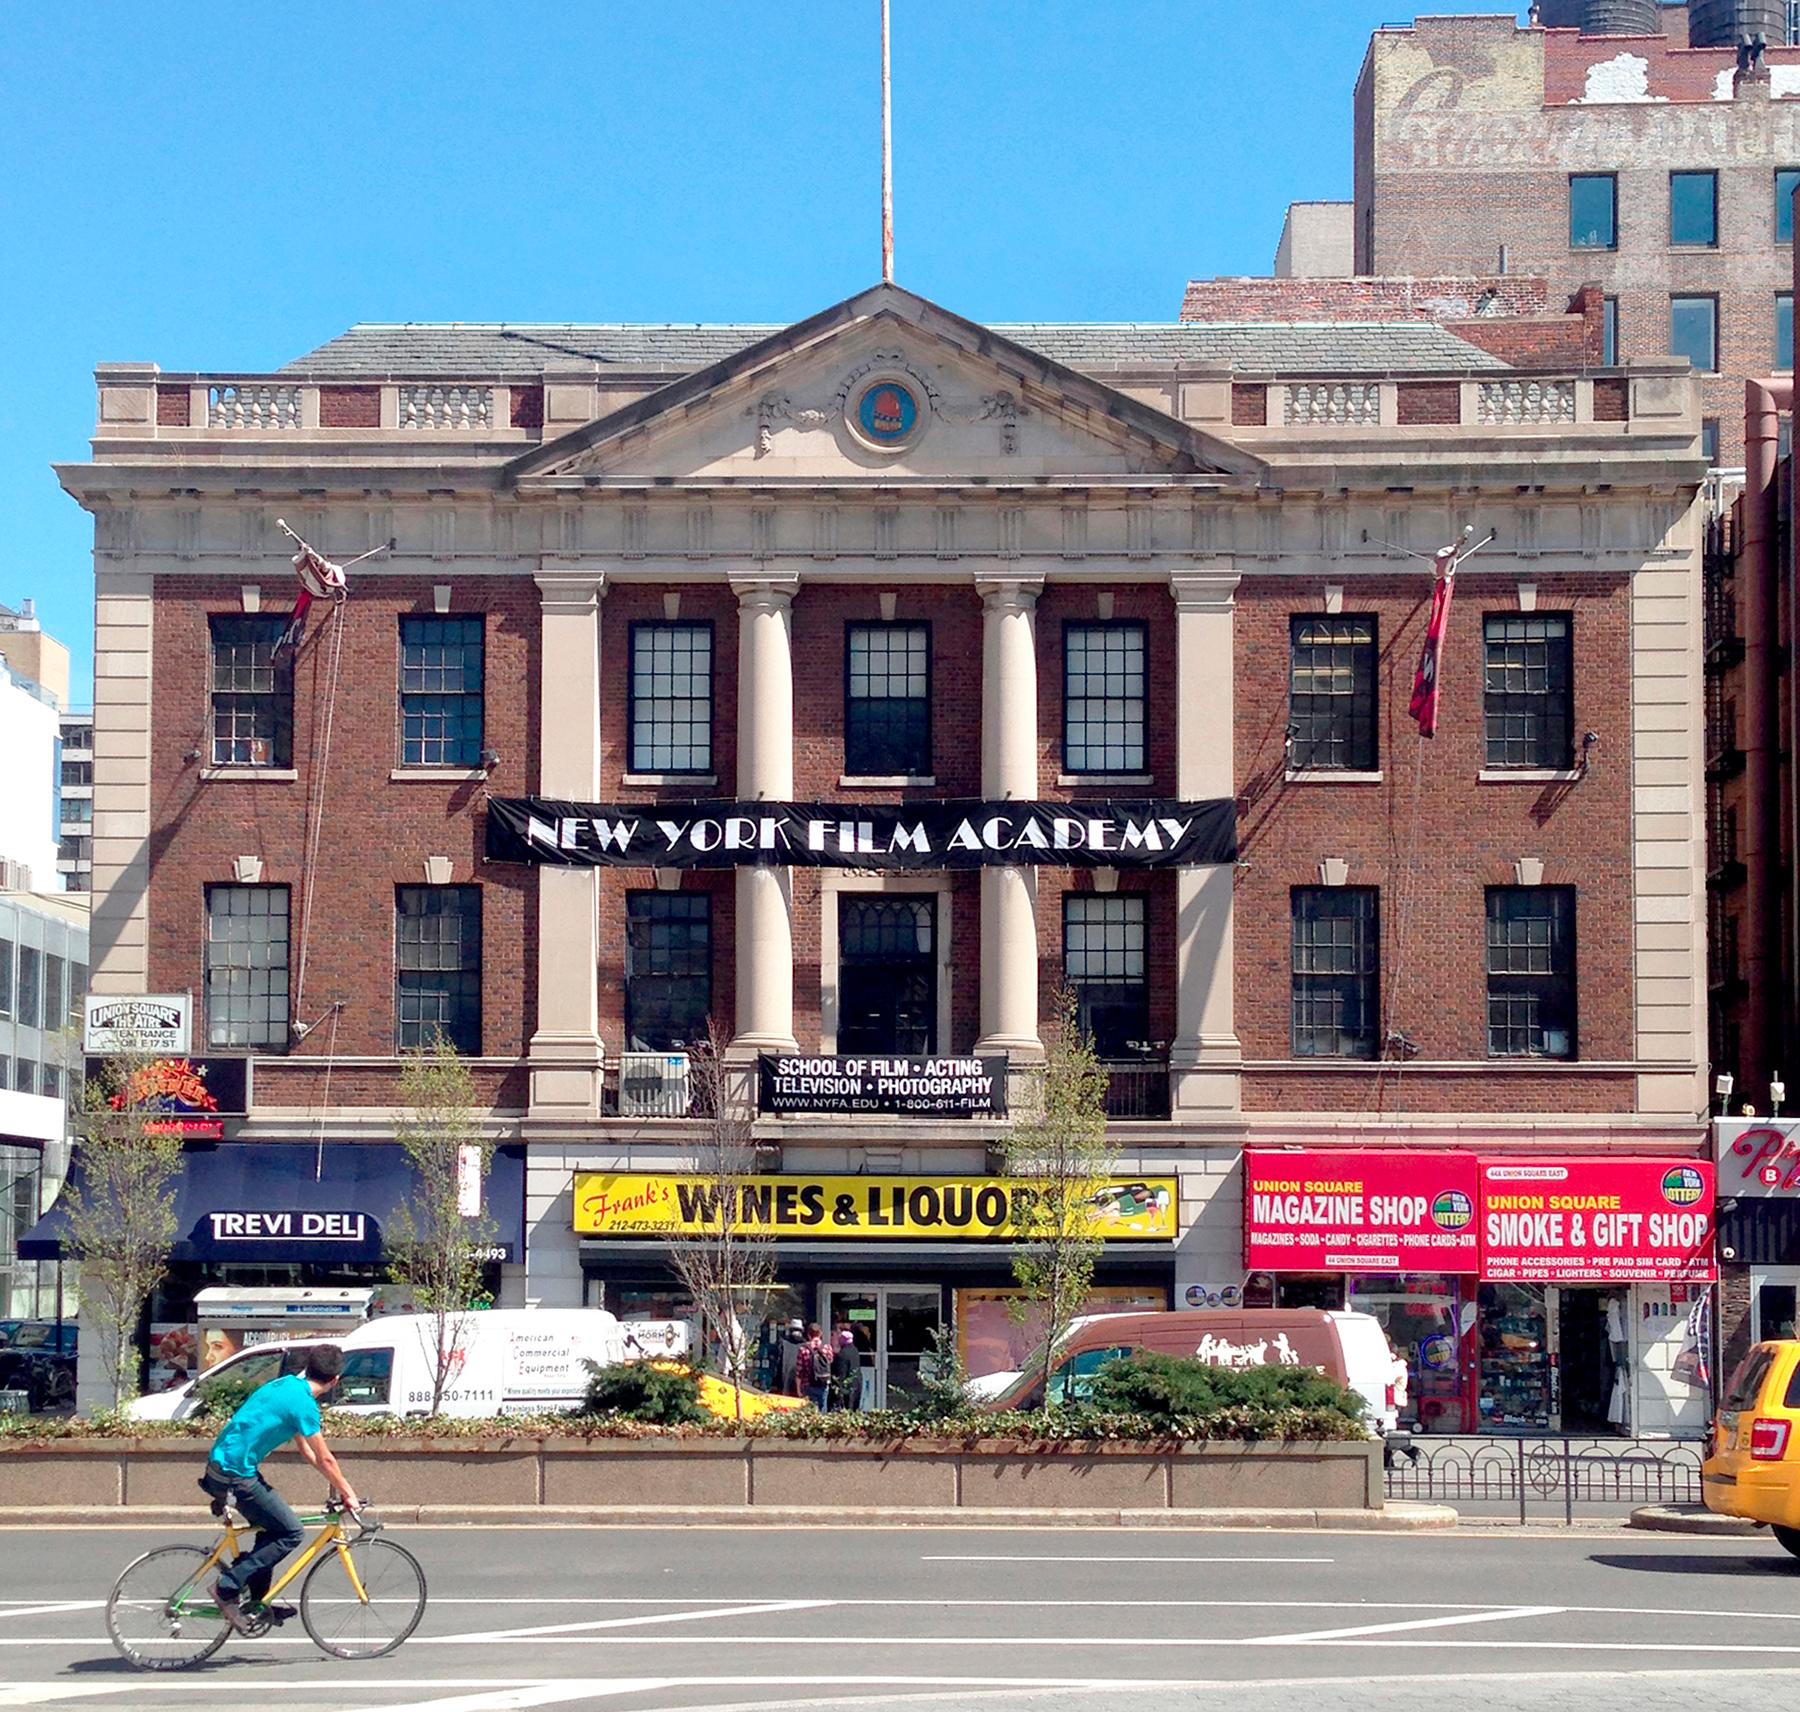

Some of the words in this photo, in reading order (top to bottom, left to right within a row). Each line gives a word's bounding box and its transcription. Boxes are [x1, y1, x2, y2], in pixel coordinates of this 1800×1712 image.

[528, 815, 639, 852] NEW
[656, 817, 792, 851] YORK
[809, 819, 931, 853] FILM
[947, 816, 1193, 850] ACADEMY
[92, 1003, 130, 1026] UNION
[132, 1002, 179, 1026] SQUARE
[112, 1014, 162, 1028] THEATRE
[119, 1029, 177, 1039] ENTRANCE
[778, 1058, 842, 1076] SCHOOL
[846, 1059, 867, 1076] OF
[871, 1060, 909, 1076] FILM
[925, 1059, 983, 1076] ACTING
[773, 1077, 861, 1095] TELEVISION
[878, 1077, 993, 1095] PHOTOGRAPHY
[772, 1097, 879, 1109] WWW.NYFA.EDU
[895, 1098, 991, 1109] 1-800-611-FILM
[1765, 1169, 1777, 1182] B
[1253, 1181, 1300, 1192] UNION
[1304, 1181, 1363, 1193] SQUARE
[583, 1180, 670, 1227] Frank's
[676, 1185, 824, 1225] WINES
[832, 1194, 861, 1226] &
[1487, 1196, 1543, 1209] UNION
[1549, 1196, 1620, 1209] SQUARE
[1253, 1195, 1364, 1225] MAGAZINE
[1369, 1196, 1427, 1225] SHOP
[210, 1214, 291, 1240] TREVI
[302, 1214, 365, 1240] DELI
[608, 1220, 676, 1231] 212-473-3231
[1487, 1213, 1563, 1247] SMOKE
[1570, 1213, 1586, 1247] &
[1593, 1213, 1643, 1247] GIFT
[1649, 1214, 1708, 1248] SHOP
[1251, 1233, 1294, 1245] MAGAZINES
[1299, 1233, 1320, 1245] SODA
[1325, 1233, 1350, 1246] CANDY
[1356, 1233, 1398, 1246] CIGARETTES
[1403, 1234, 1430, 1246] PHONE
[1431, 1234, 1456, 1246] CARDS
[1459, 1234, 1476, 1247] ATM
[1487, 1257, 1519, 1266] PHONE
[1521, 1257, 1585, 1266] ACCESSORIES
[1592, 1257, 1610, 1266] PRE
[1613, 1257, 1634, 1266] PAID
[1636, 1257, 1653, 1266] SIM
[1656, 1257, 1681, 1266] CARD
[1689, 1257, 1708, 1267] ATM
[1487, 1269, 1515, 1278] CIGAR
[1523, 1269, 1549, 1278] PIPES
[1557, 1269, 1602, 1278] LIGHTERS
[1609, 1269, 1656, 1278] SOUVENIR
[1664, 1269, 1709, 1278] PERFUME
[514, 1346, 570, 1360] Commercial
[519, 1361, 569, 1375] Equipment
[409, 1390, 493, 1402] 888-50-7111
